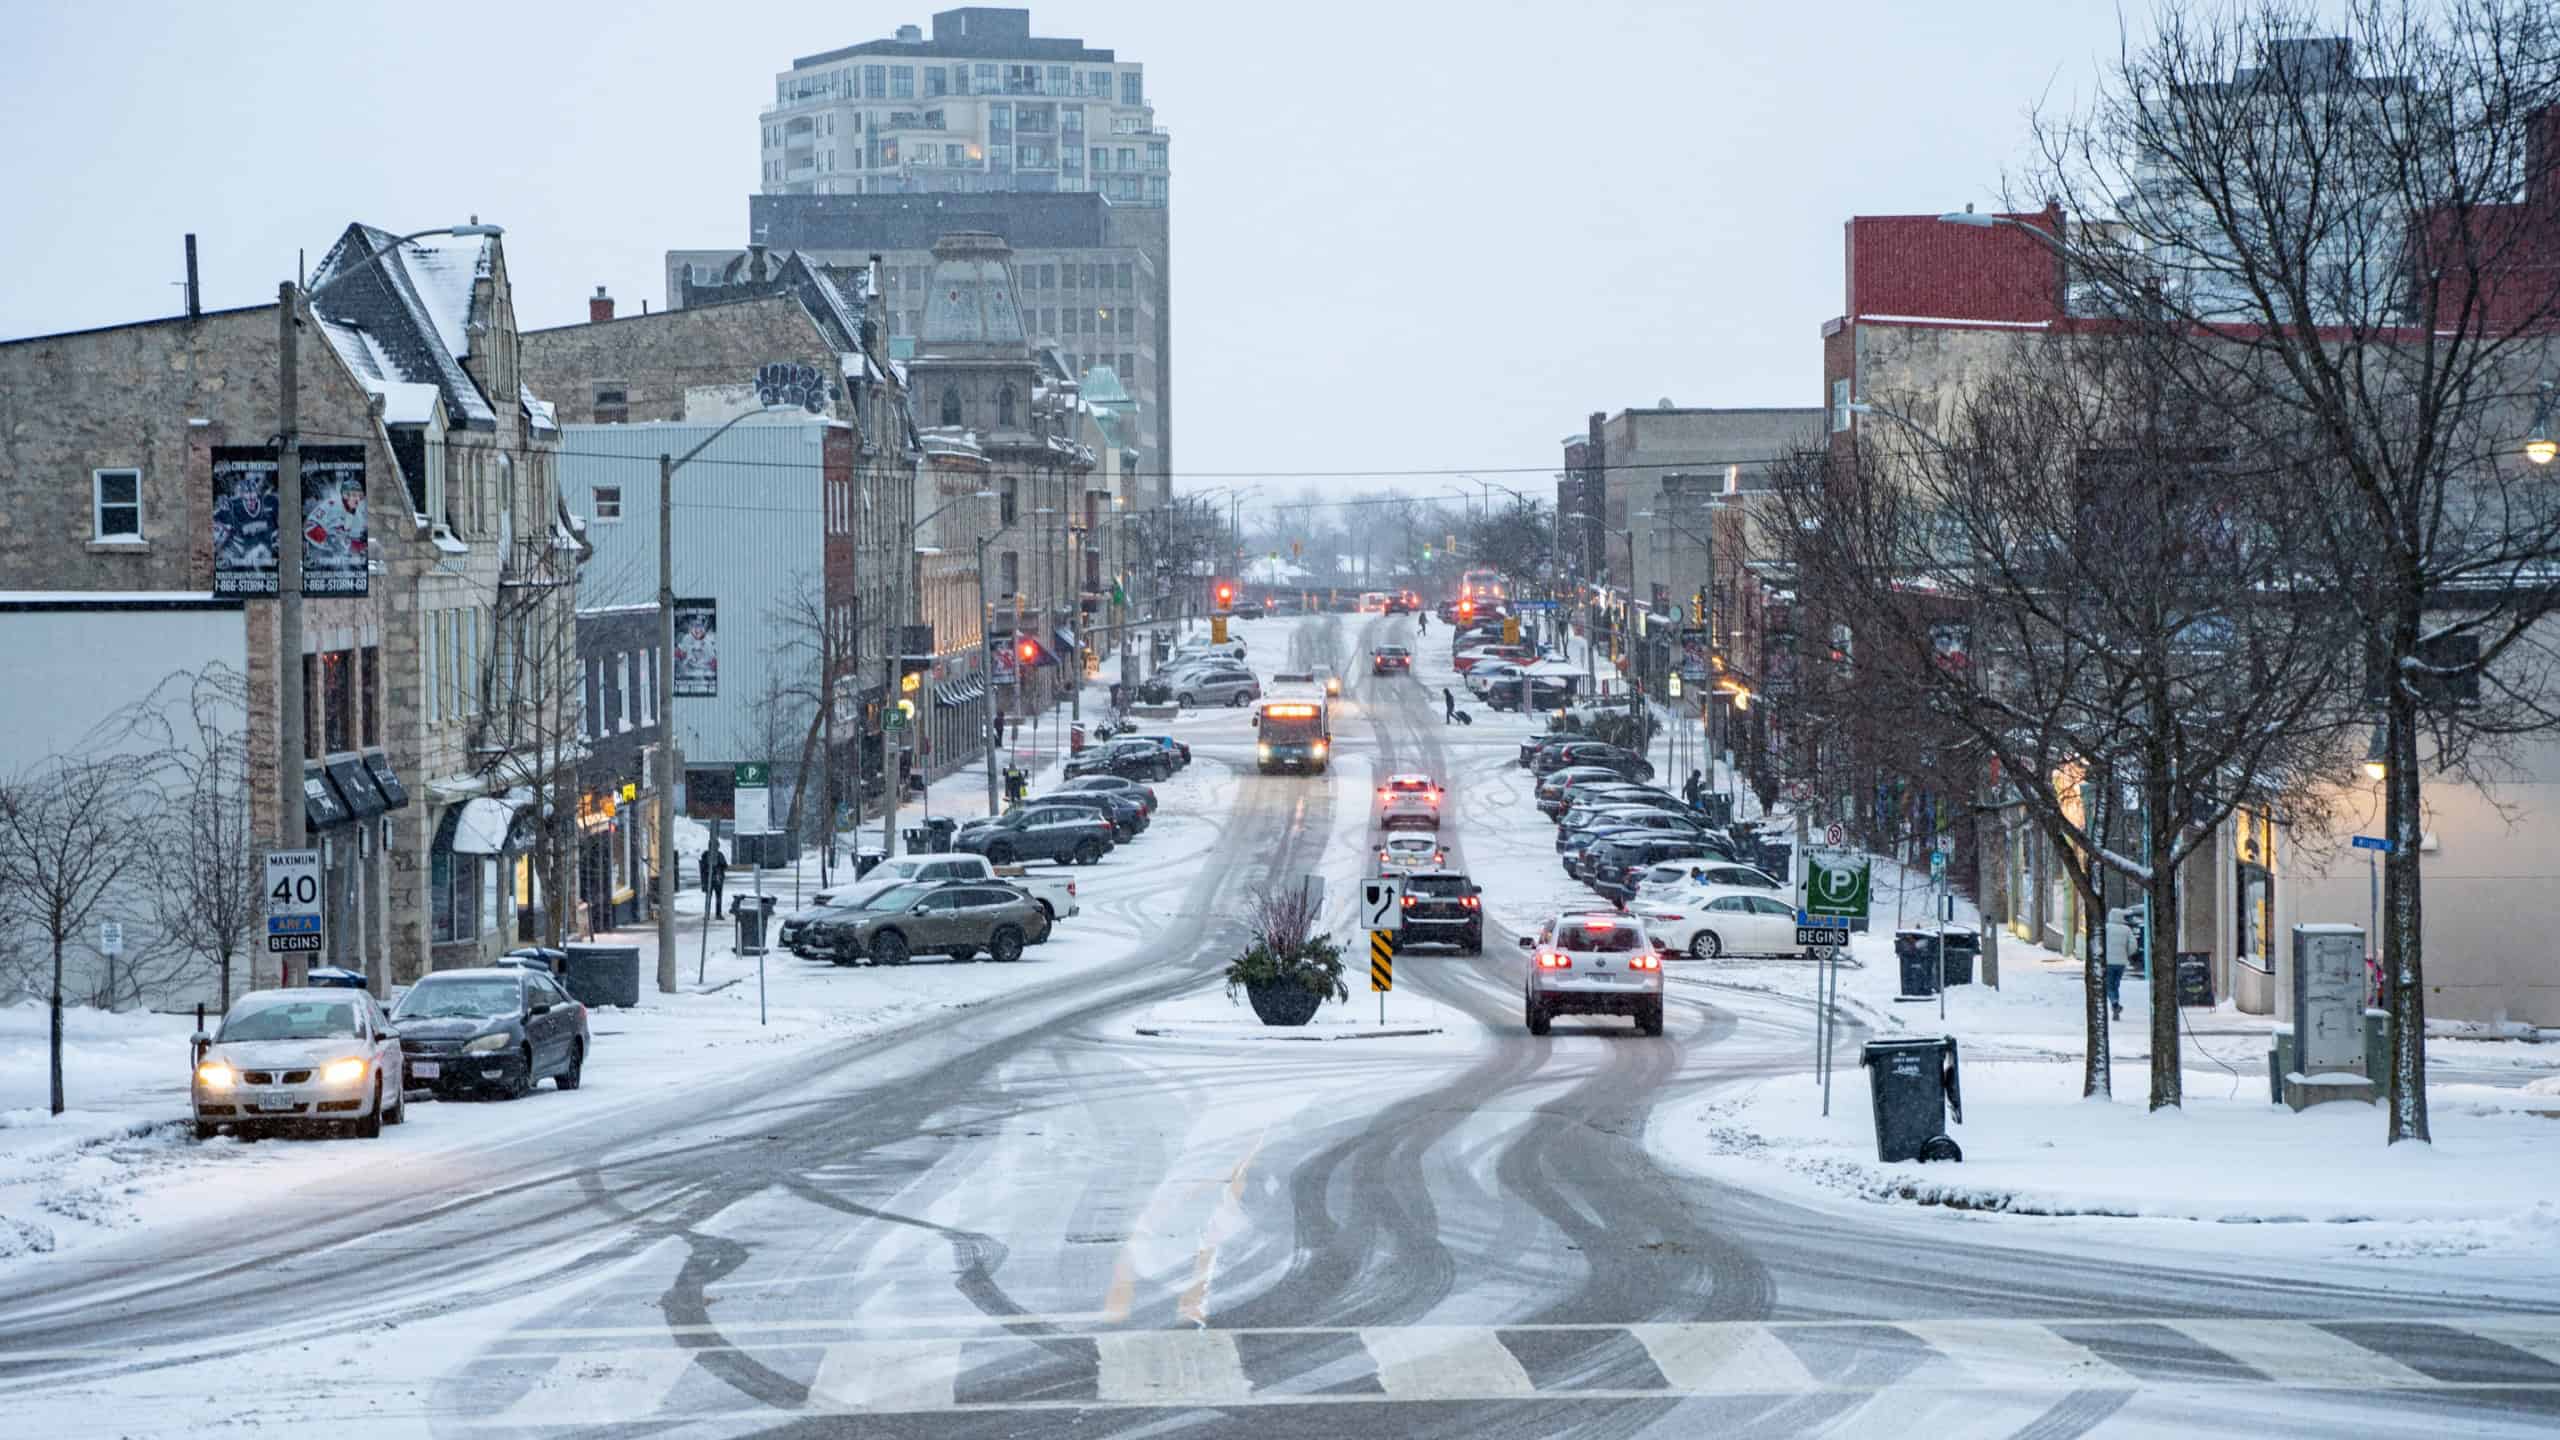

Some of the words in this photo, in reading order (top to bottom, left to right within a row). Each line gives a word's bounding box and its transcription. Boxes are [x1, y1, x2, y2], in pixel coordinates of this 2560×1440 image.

[270, 855, 316, 866] MAXIMUM
[271, 874, 317, 905] 40
[1830, 868, 1852, 895] P
[271, 936, 319, 951] BEGINS
